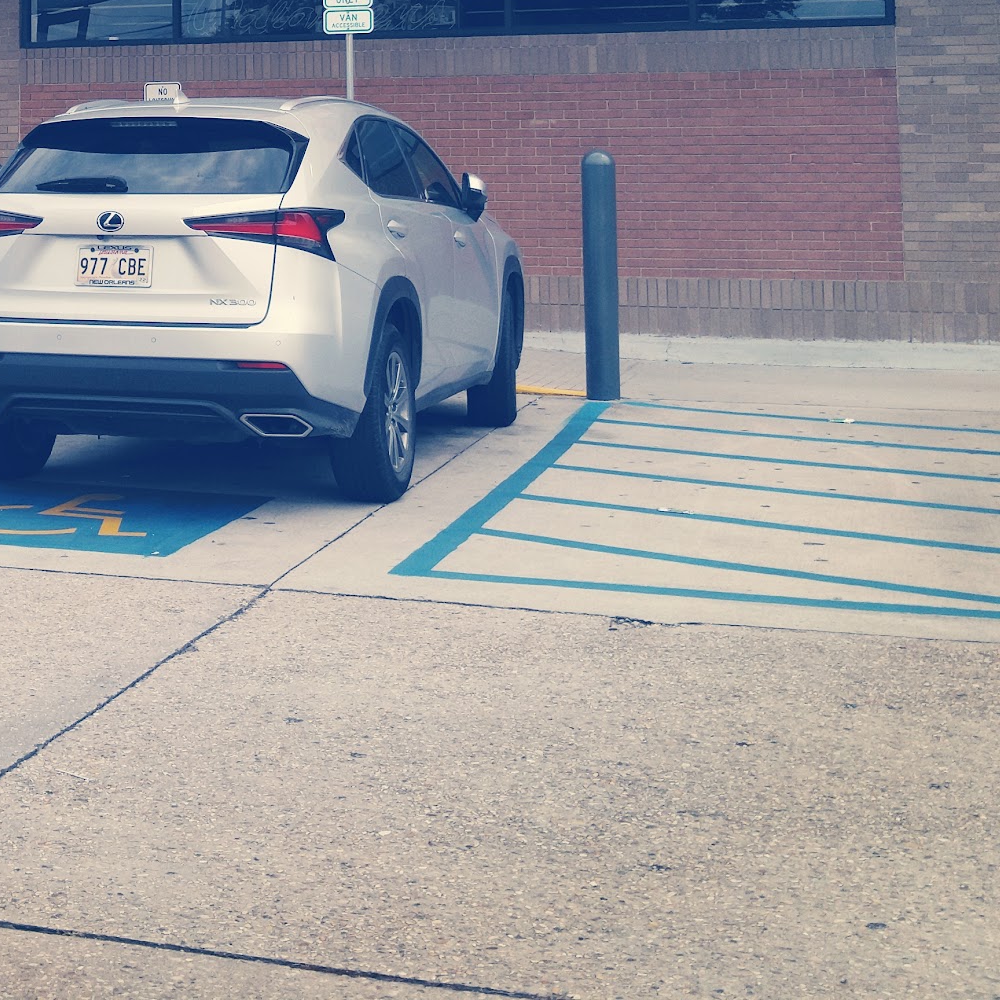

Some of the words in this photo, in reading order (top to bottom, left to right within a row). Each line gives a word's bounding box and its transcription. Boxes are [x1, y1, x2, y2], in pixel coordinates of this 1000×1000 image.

[339, 13, 358, 22] VAN
[158, 88, 168, 96] NO
[80, 257, 108, 275] 977
[118, 257, 147, 276] CBE
[209, 298, 228, 306] NX
